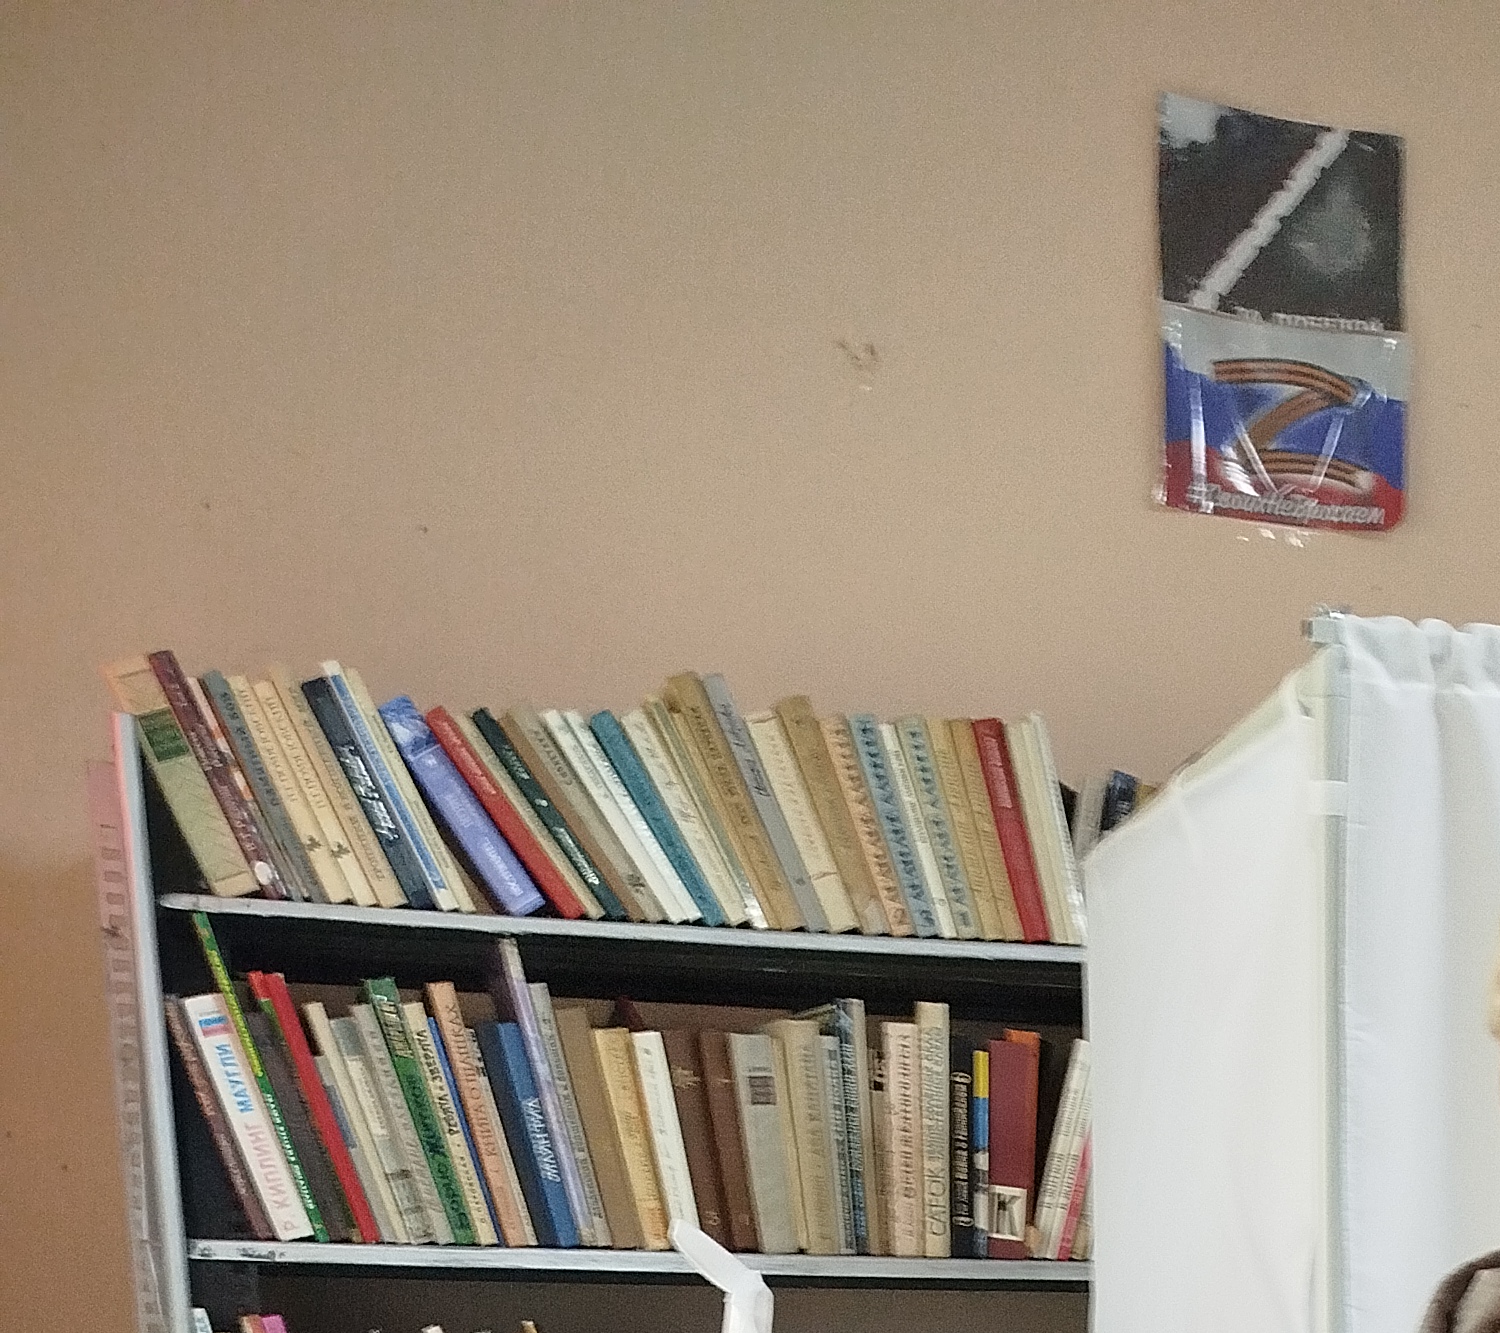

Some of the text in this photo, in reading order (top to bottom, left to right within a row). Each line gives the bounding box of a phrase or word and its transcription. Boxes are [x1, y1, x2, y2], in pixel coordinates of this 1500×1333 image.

[213, 1040, 255, 1115] МАУГЛИ
[414, 1028, 443, 1084] ЗВЕРЯТА
[470, 1103, 499, 1159] КНИГА
[242, 1118, 292, 1210] КИПЛИНГ
